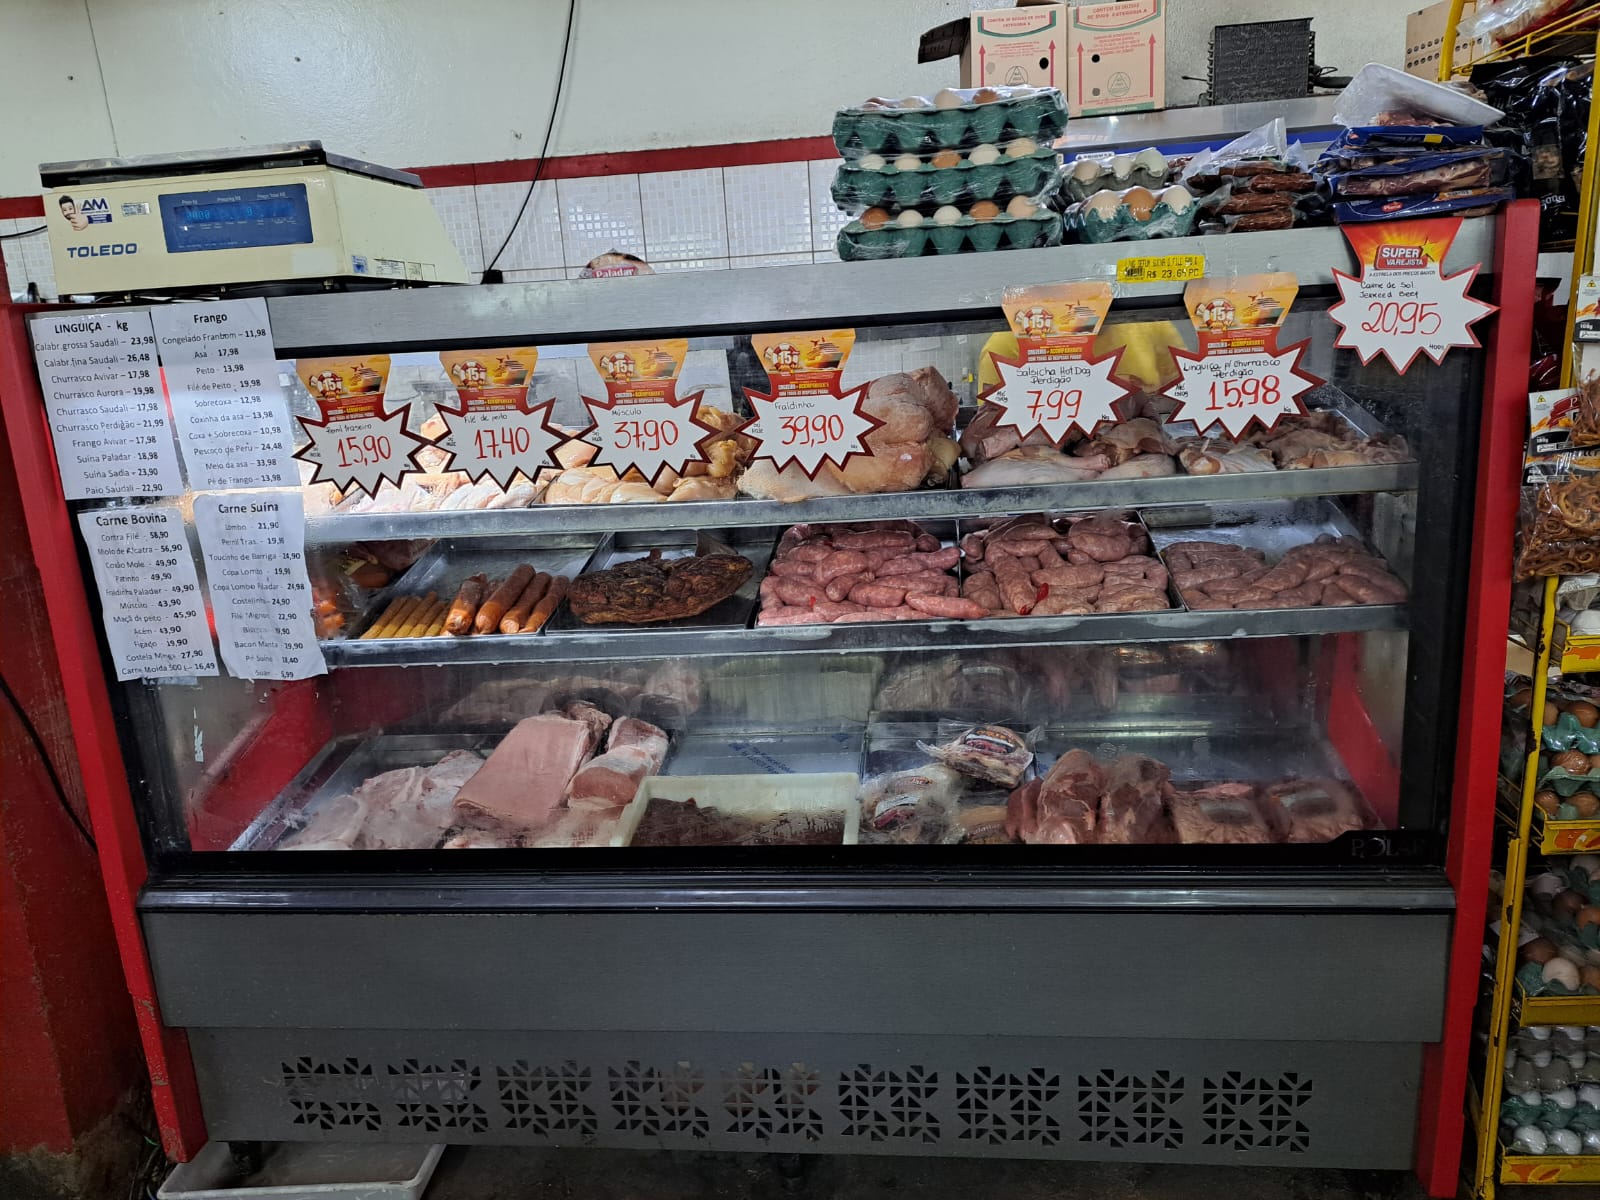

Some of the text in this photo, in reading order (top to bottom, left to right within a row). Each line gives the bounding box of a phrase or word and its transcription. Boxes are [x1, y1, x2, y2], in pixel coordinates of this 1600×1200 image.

[66, 243, 138, 258] TOLEDO
[1381, 247, 1420, 258] SUPER
[1386, 258, 1424, 266] VAREJISTA
[193, 313, 228, 324] Frango
[1361, 301, 1442, 336] 20,95
[54, 320, 129, 334] LINGUIÇA kg
[89, 338, 120, 348] Saudali
[130, 336, 155, 346] 23,98
[162, 333, 202, 346] Congelado
[244, 328, 267, 339] 11,98
[217, 347, 240, 357] 17,98
[88, 353, 150, 366] Saudali 26,48
[196, 363, 245, 375] Peito 13,98
[1016, 366, 1056, 377] Salsicha
[51, 370, 150, 384] Churrasco Avivar 17,98
[1030, 376, 1072, 388] Perdigão
[212, 380, 232, 390] Peito
[239, 379, 262, 389] 19,98
[53, 387, 155, 400] Churrasco Aurora 19,98
[1205, 374, 1282, 411] 15,98
[194, 395, 262, 408] Sobrecoxa 12,98
[774, 401, 815, 411] Fraldinha
[1026, 389, 1083, 423] 7,99
[56, 402, 159, 416] Churrasco Saudali 17,98
[611, 408, 642, 416] Músculo
[189, 410, 274, 424] Coxinha da asa 13,98
[56, 419, 164, 433] Churrasco Perdigão 21,99
[778, 414, 844, 448] 39,90
[188, 431, 206, 441] Coxa
[213, 429, 252, 439] Sobrecoxa
[259, 426, 282, 436] 10,98
[613, 419, 679, 452] 37,90
[72, 435, 157, 449] Frango Avivar 17,98
[474, 426, 530, 460] 17,40
[193, 447, 223, 457] Pescoço
[260, 442, 283, 451] 24,48
[337, 435, 392, 468] 15,90
[102, 451, 159, 462] Paladar 18,98
[235, 460, 249, 469] asa
[255, 458, 278, 468] 33,98
[137, 467, 159, 477] 23,90
[260, 473, 282, 483] 13,98
[106, 483, 134, 494] Saudali
[141, 483, 163, 493] 22,90
[218, 501, 279, 514] Carne Suína
[95, 512, 168, 527] Carne Bovina
[160, 544, 183, 553] 56,90
[155, 558, 178, 567] 49,90
[240, 552, 250, 561] de
[157, 598, 182, 608] 43,90
[173, 610, 197, 619] 45,90
[180, 649, 203, 660] 27,90
